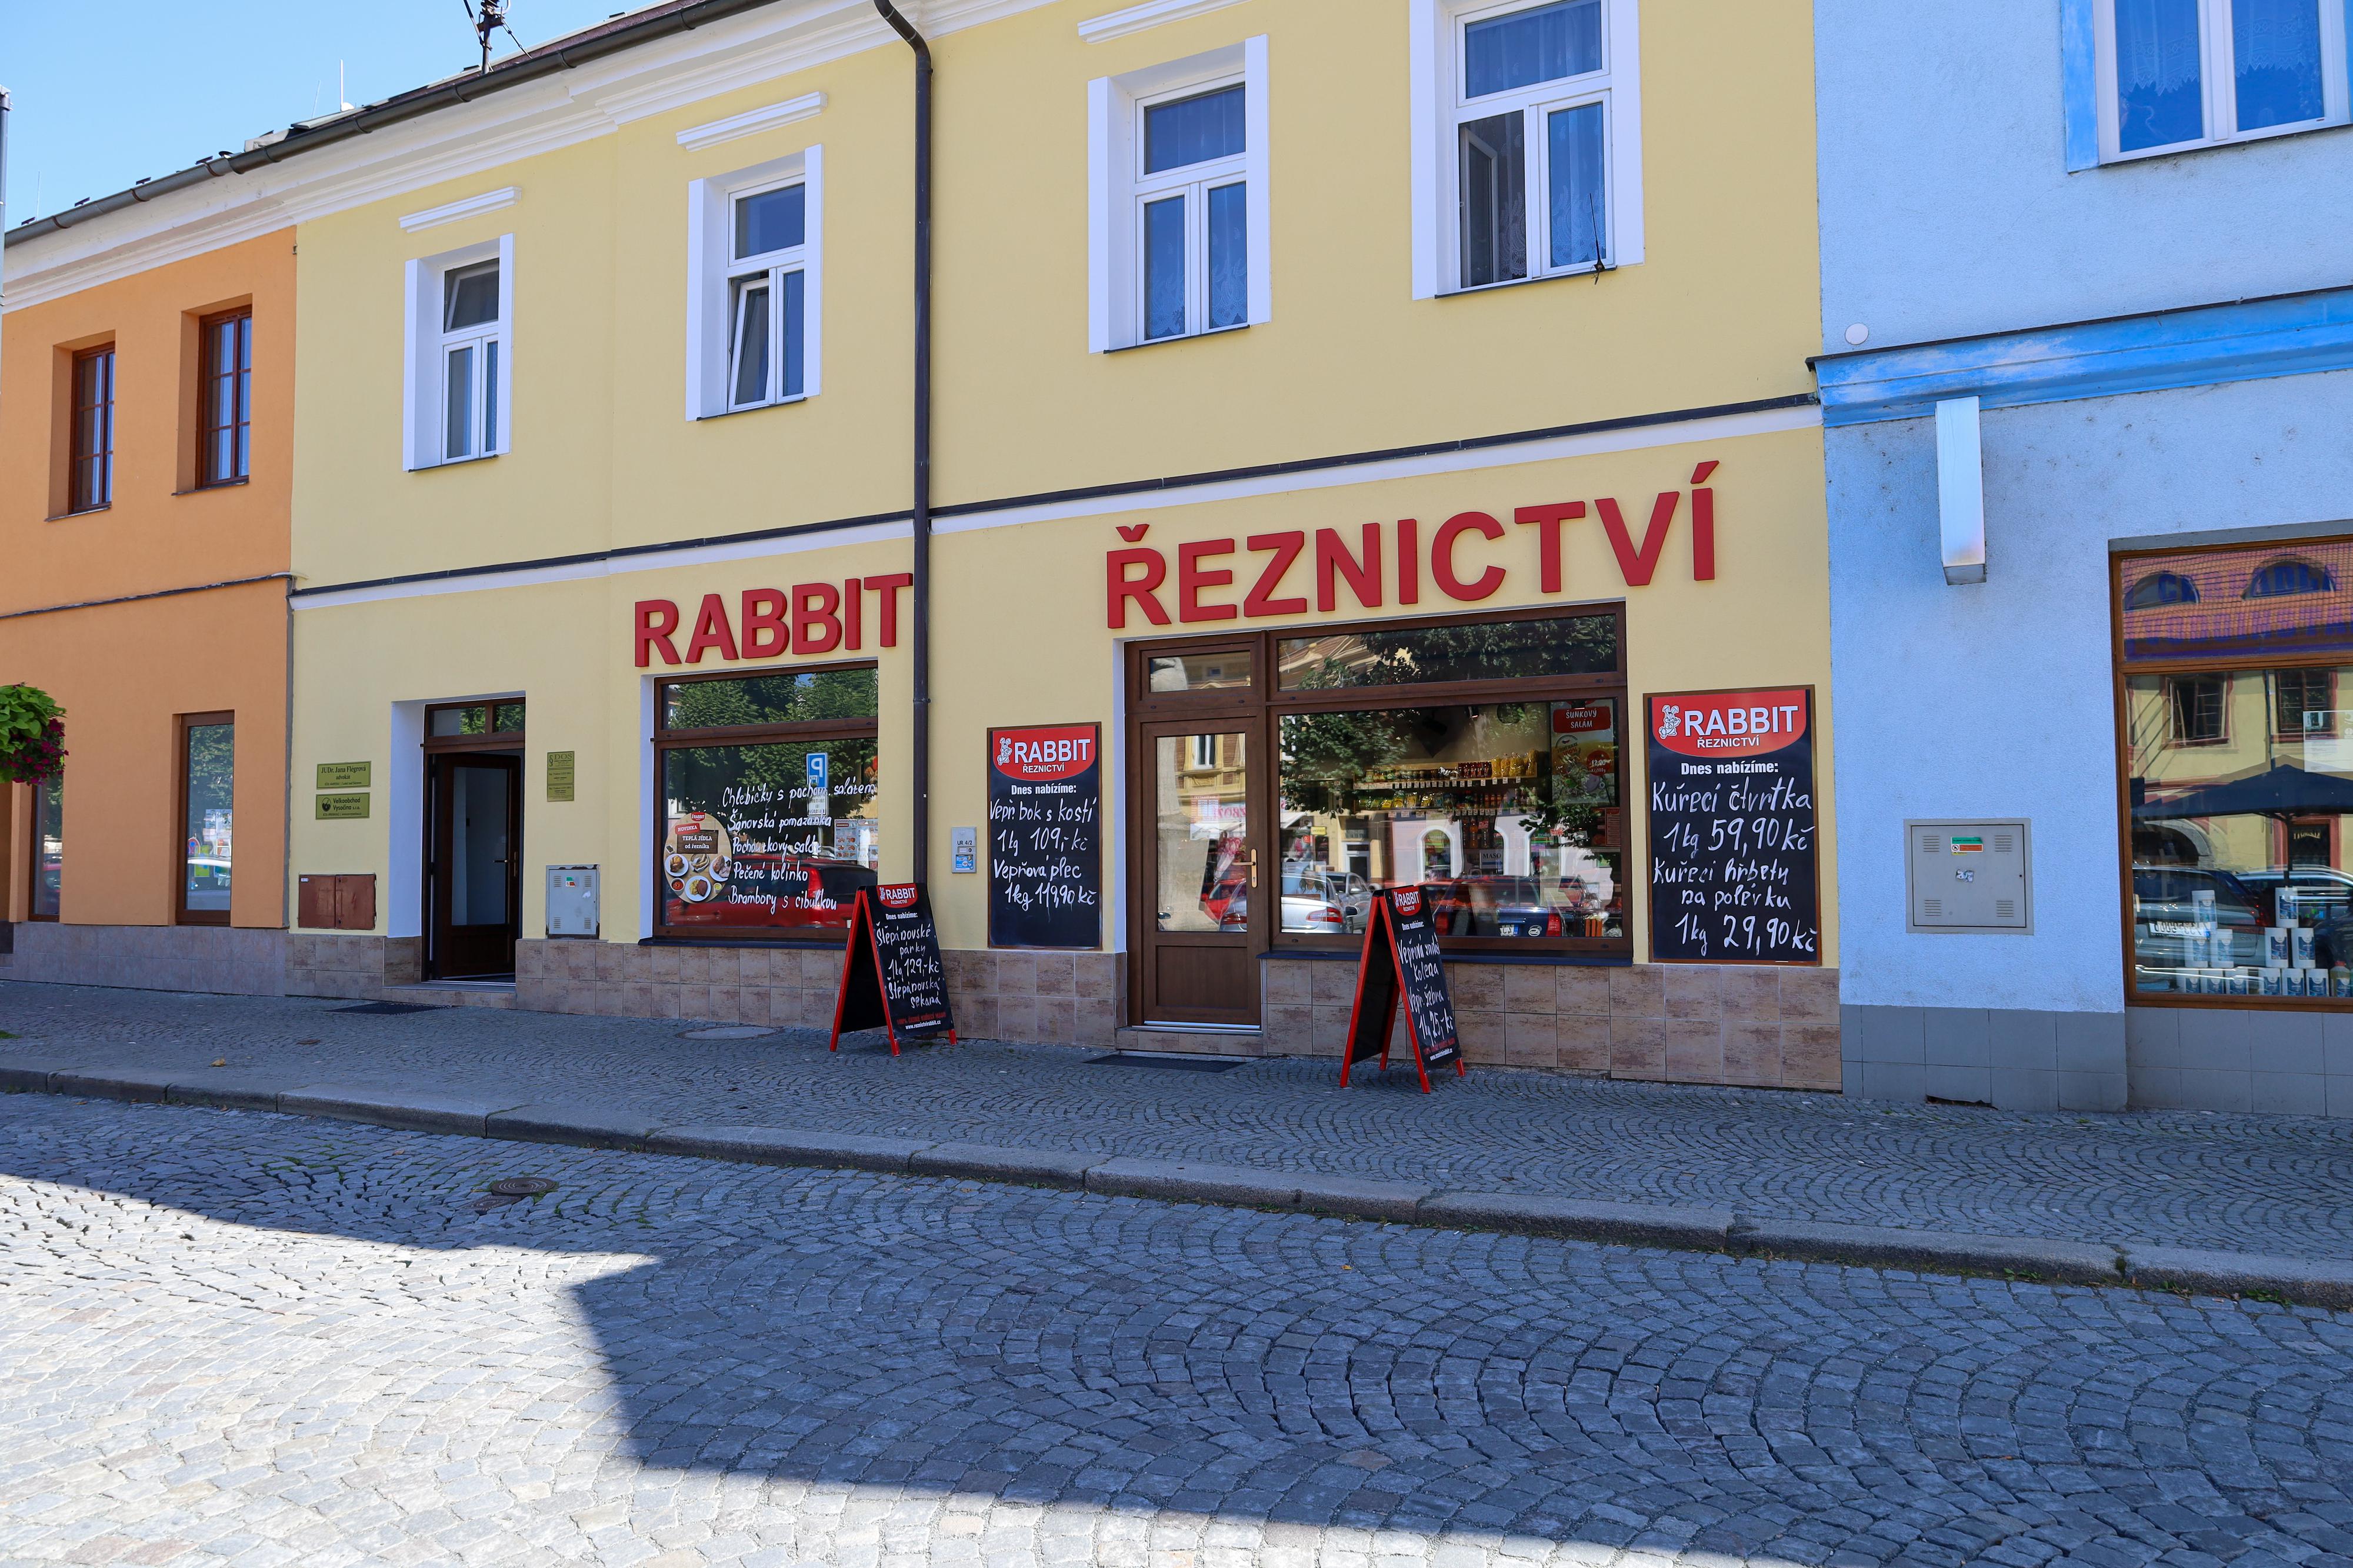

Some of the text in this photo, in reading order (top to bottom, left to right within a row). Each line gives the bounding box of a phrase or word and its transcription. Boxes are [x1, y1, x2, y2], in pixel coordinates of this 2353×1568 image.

[1106, 460, 1719, 629] ŘEZNICTVÍ
[635, 572, 913, 667] RABBIT
[1566, 708, 1597, 719] ŠUNKOVÝ
[1684, 705, 1798, 736] RABBIT
[1571, 719, 1592, 729] SALÁM
[1697, 735, 1759, 748] ŘEZNICTVÍ
[1015, 739, 1091, 763] RABBIT
[1022, 762, 1064, 773] ŘEZNICTVÍ
[1681, 760, 1778, 775] Dnes nabízíme:
[776, 789, 784, 800] s
[1011, 783, 1076, 795] Dnes nabízíme:
[1729, 776, 1812, 812] čtvrtka
[1019, 800, 1041, 820] bok
[1046, 809, 1052, 821] s
[1058, 796, 1096, 823] kostí
[734, 861, 765, 880] Pečené
[1049, 856, 1082, 882] plec
[728, 885, 776, 915] Brambory
[782, 895, 788, 908] s
[885, 888, 915, 900] RABBIT
[1398, 891, 1419, 906] RABBIT
[1681, 889, 1705, 906] na
[899, 941, 926, 959] párky
[911, 991, 941, 1009] sekaná
